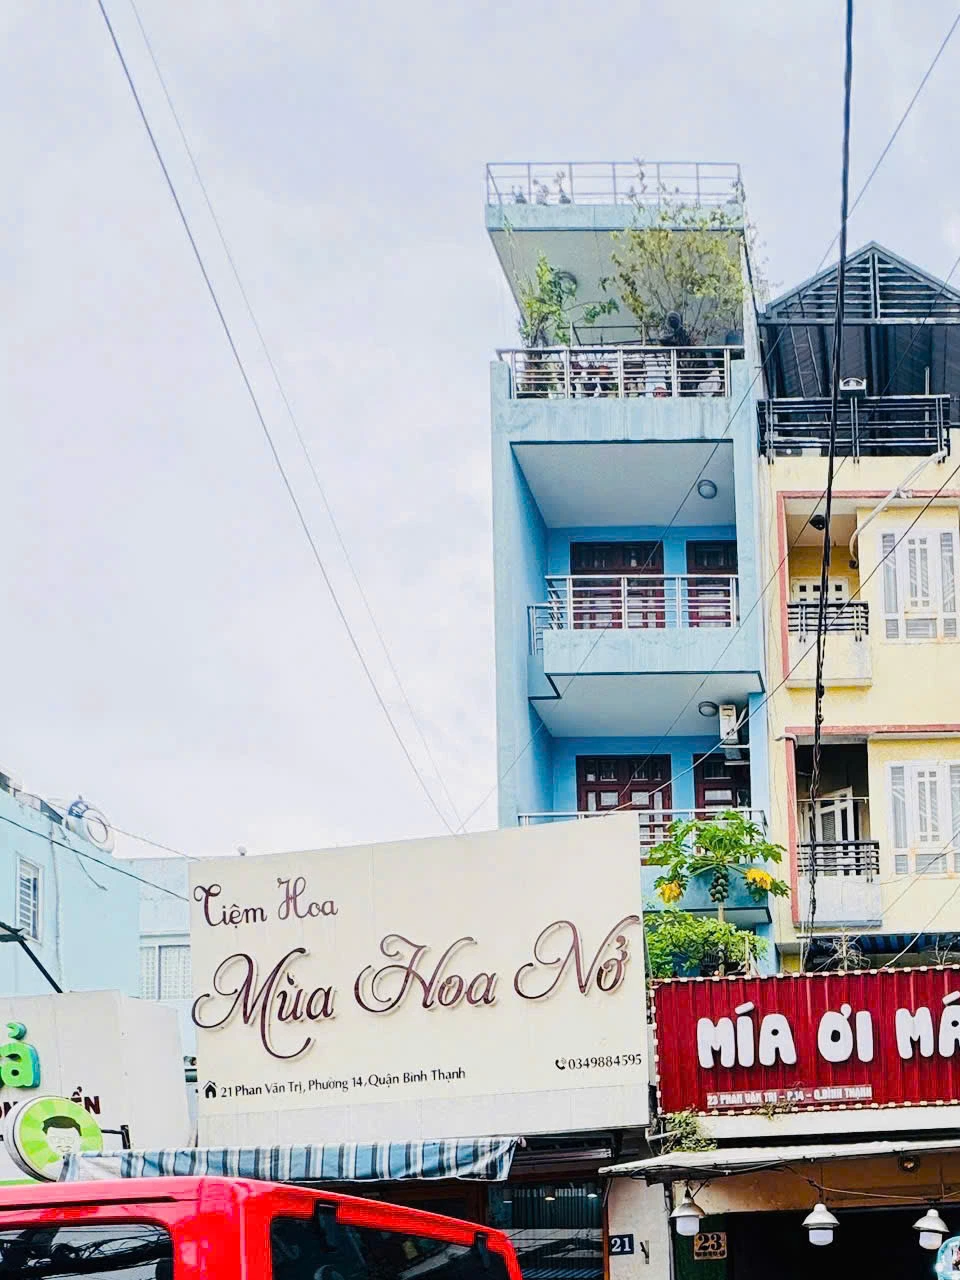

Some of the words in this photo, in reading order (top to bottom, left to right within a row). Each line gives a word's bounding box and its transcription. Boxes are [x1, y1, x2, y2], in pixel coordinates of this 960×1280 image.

[193, 883, 267, 928] Tiệm
[277, 876, 338, 920] Hoa
[191, 947, 335, 1059] Mùa
[354, 934, 499, 1013] Hoa
[514, 915, 640, 1000] Nở
[696, 1001, 797, 1068] MÍA
[817, 1003, 874, 1063] ƠI
[568, 1053, 642, 1070] 0349884595
[221, 1086, 232, 1098] 21
[235, 1085, 262, 1096] Phan
[431, 1067, 466, 1083] Thạnh
[707, 1095, 719, 1105] 23
[720, 1093, 743, 1105] PHAN
[611, 1238, 631, 1252] 21
[697, 1233, 722, 1251] 23
